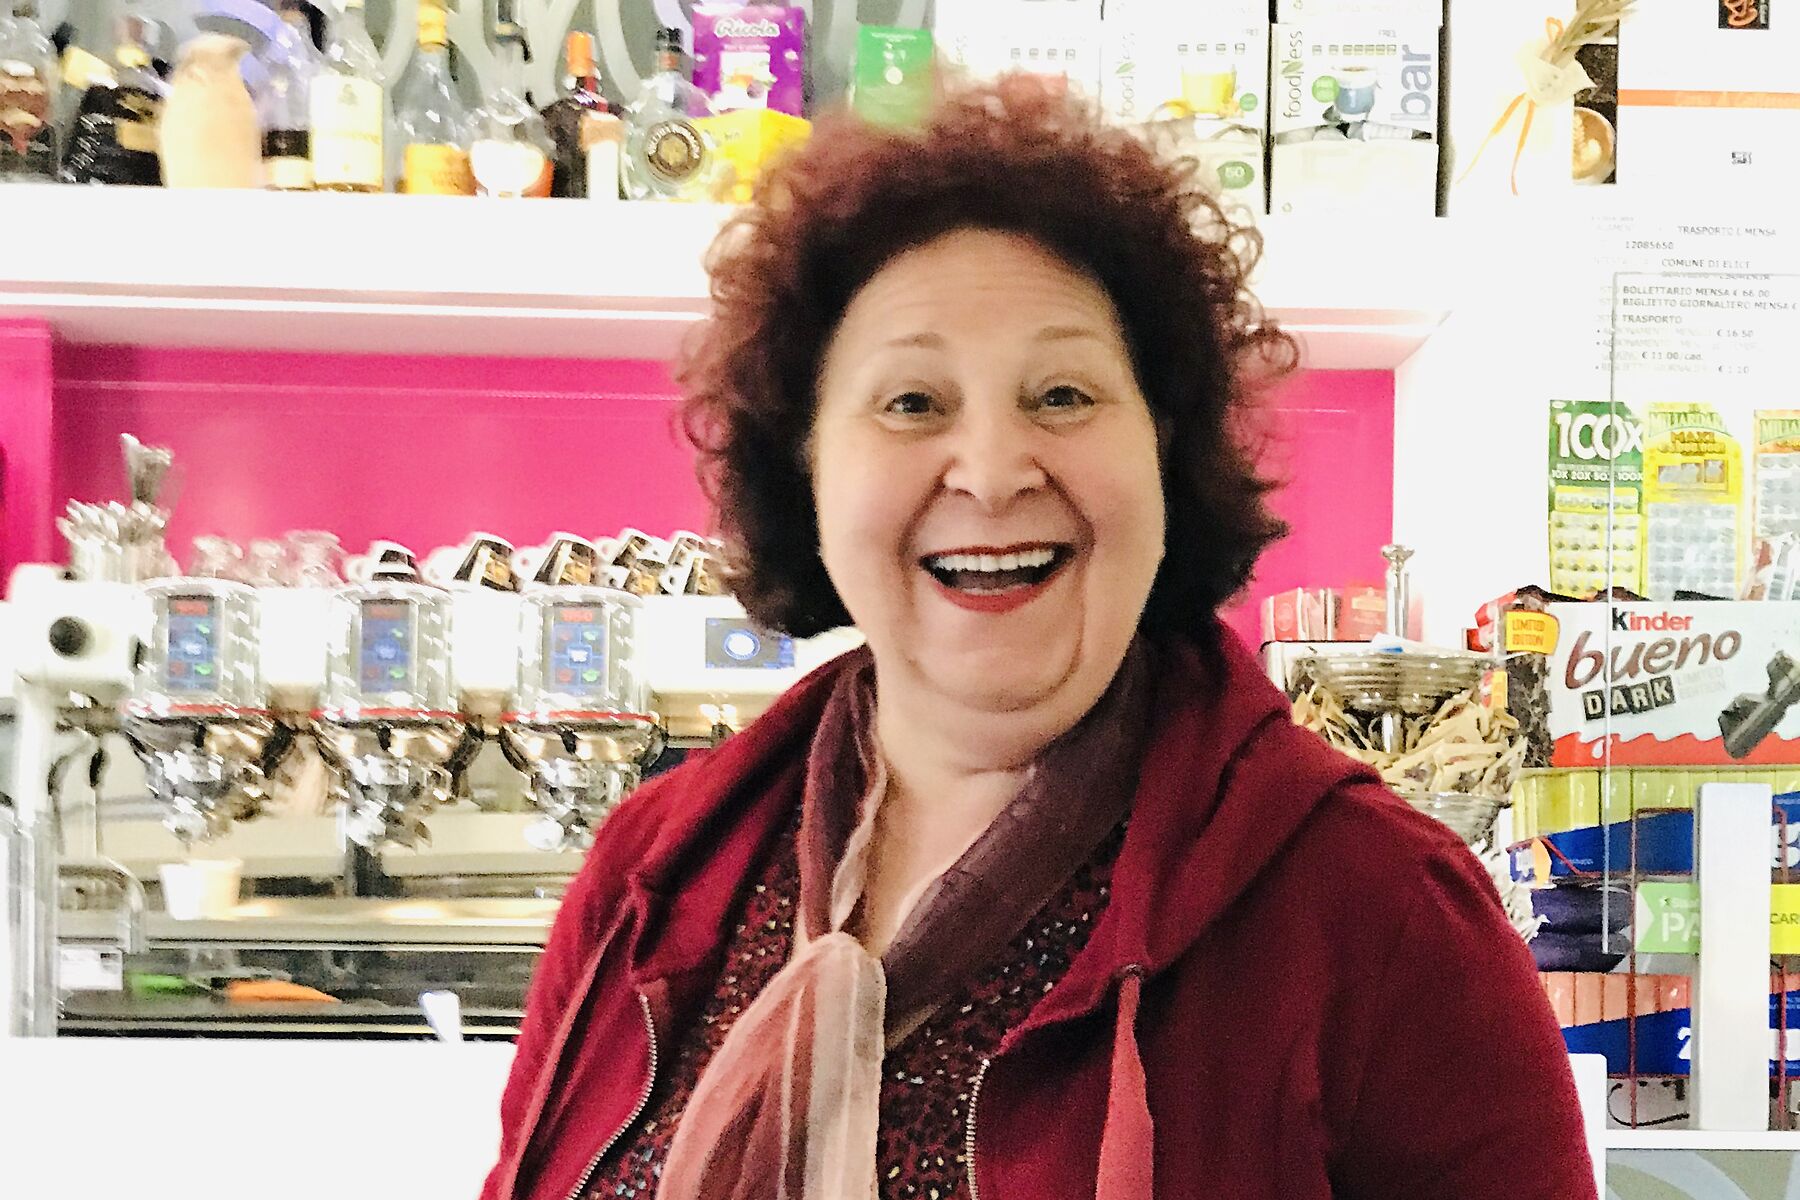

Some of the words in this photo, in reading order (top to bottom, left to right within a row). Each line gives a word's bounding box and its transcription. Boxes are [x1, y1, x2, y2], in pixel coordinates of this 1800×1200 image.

[714, 18, 780, 38] Ricola
[1391, 44, 1432, 122] bar
[1678, 225, 1733, 237] TRASPORTO
[1744, 227, 1777, 237] MENSA
[1661, 258, 1704, 268] COMUNE
[1708, 260, 1719, 268] DI
[1622, 285, 1692, 296] BOLLETTARIO
[1695, 288, 1730, 297] MENSA
[1622, 298, 1677, 308] BIGLIETTO
[1679, 299, 1751, 310] GIORNALIERO
[1754, 301, 1789, 310] MENSA
[1622, 314, 1682, 324] TRASPORTO
[1593, 471, 1611, 481] 50
[1564, 630, 1742, 690] bueno
[1583, 676, 1676, 720] DARK
